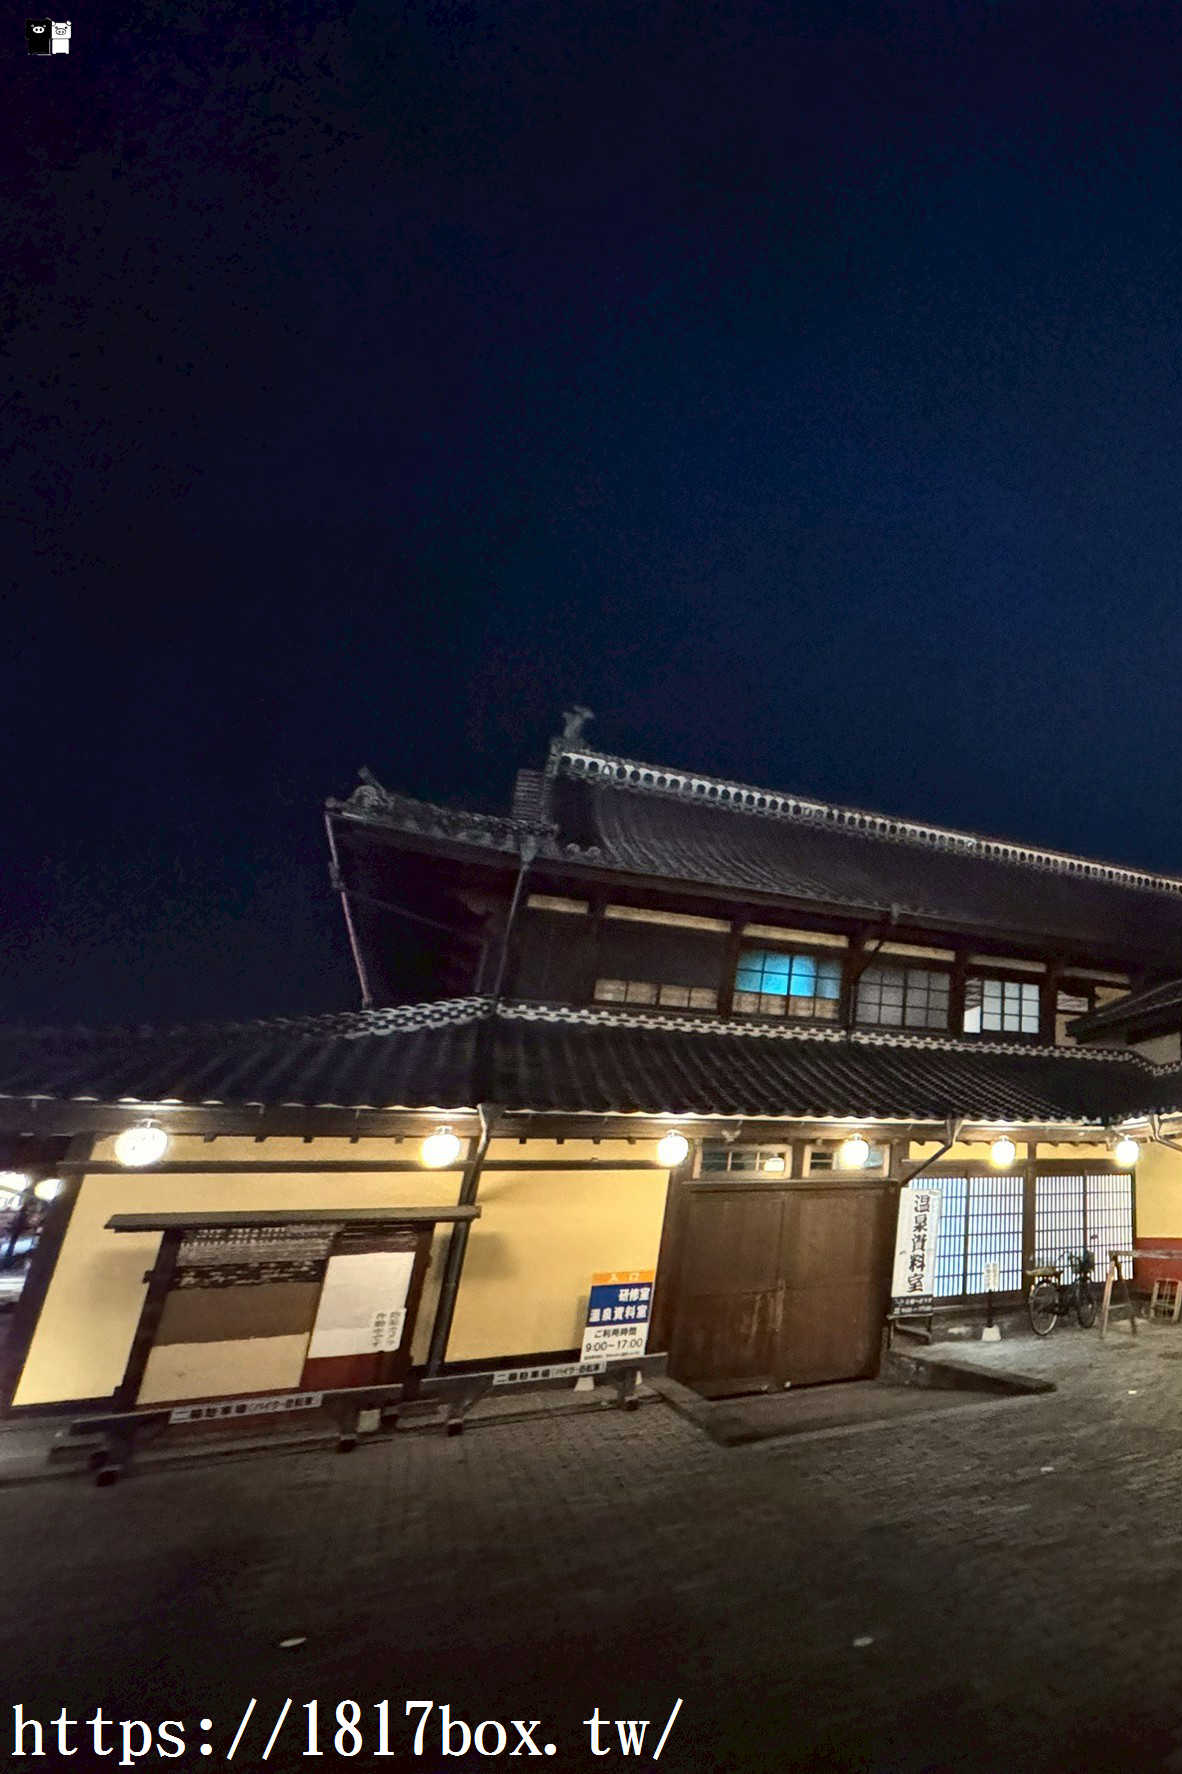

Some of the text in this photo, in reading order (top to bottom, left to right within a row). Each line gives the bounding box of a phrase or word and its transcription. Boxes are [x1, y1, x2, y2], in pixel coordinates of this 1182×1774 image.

[906, 1194, 930, 1293] 温泉資料室
